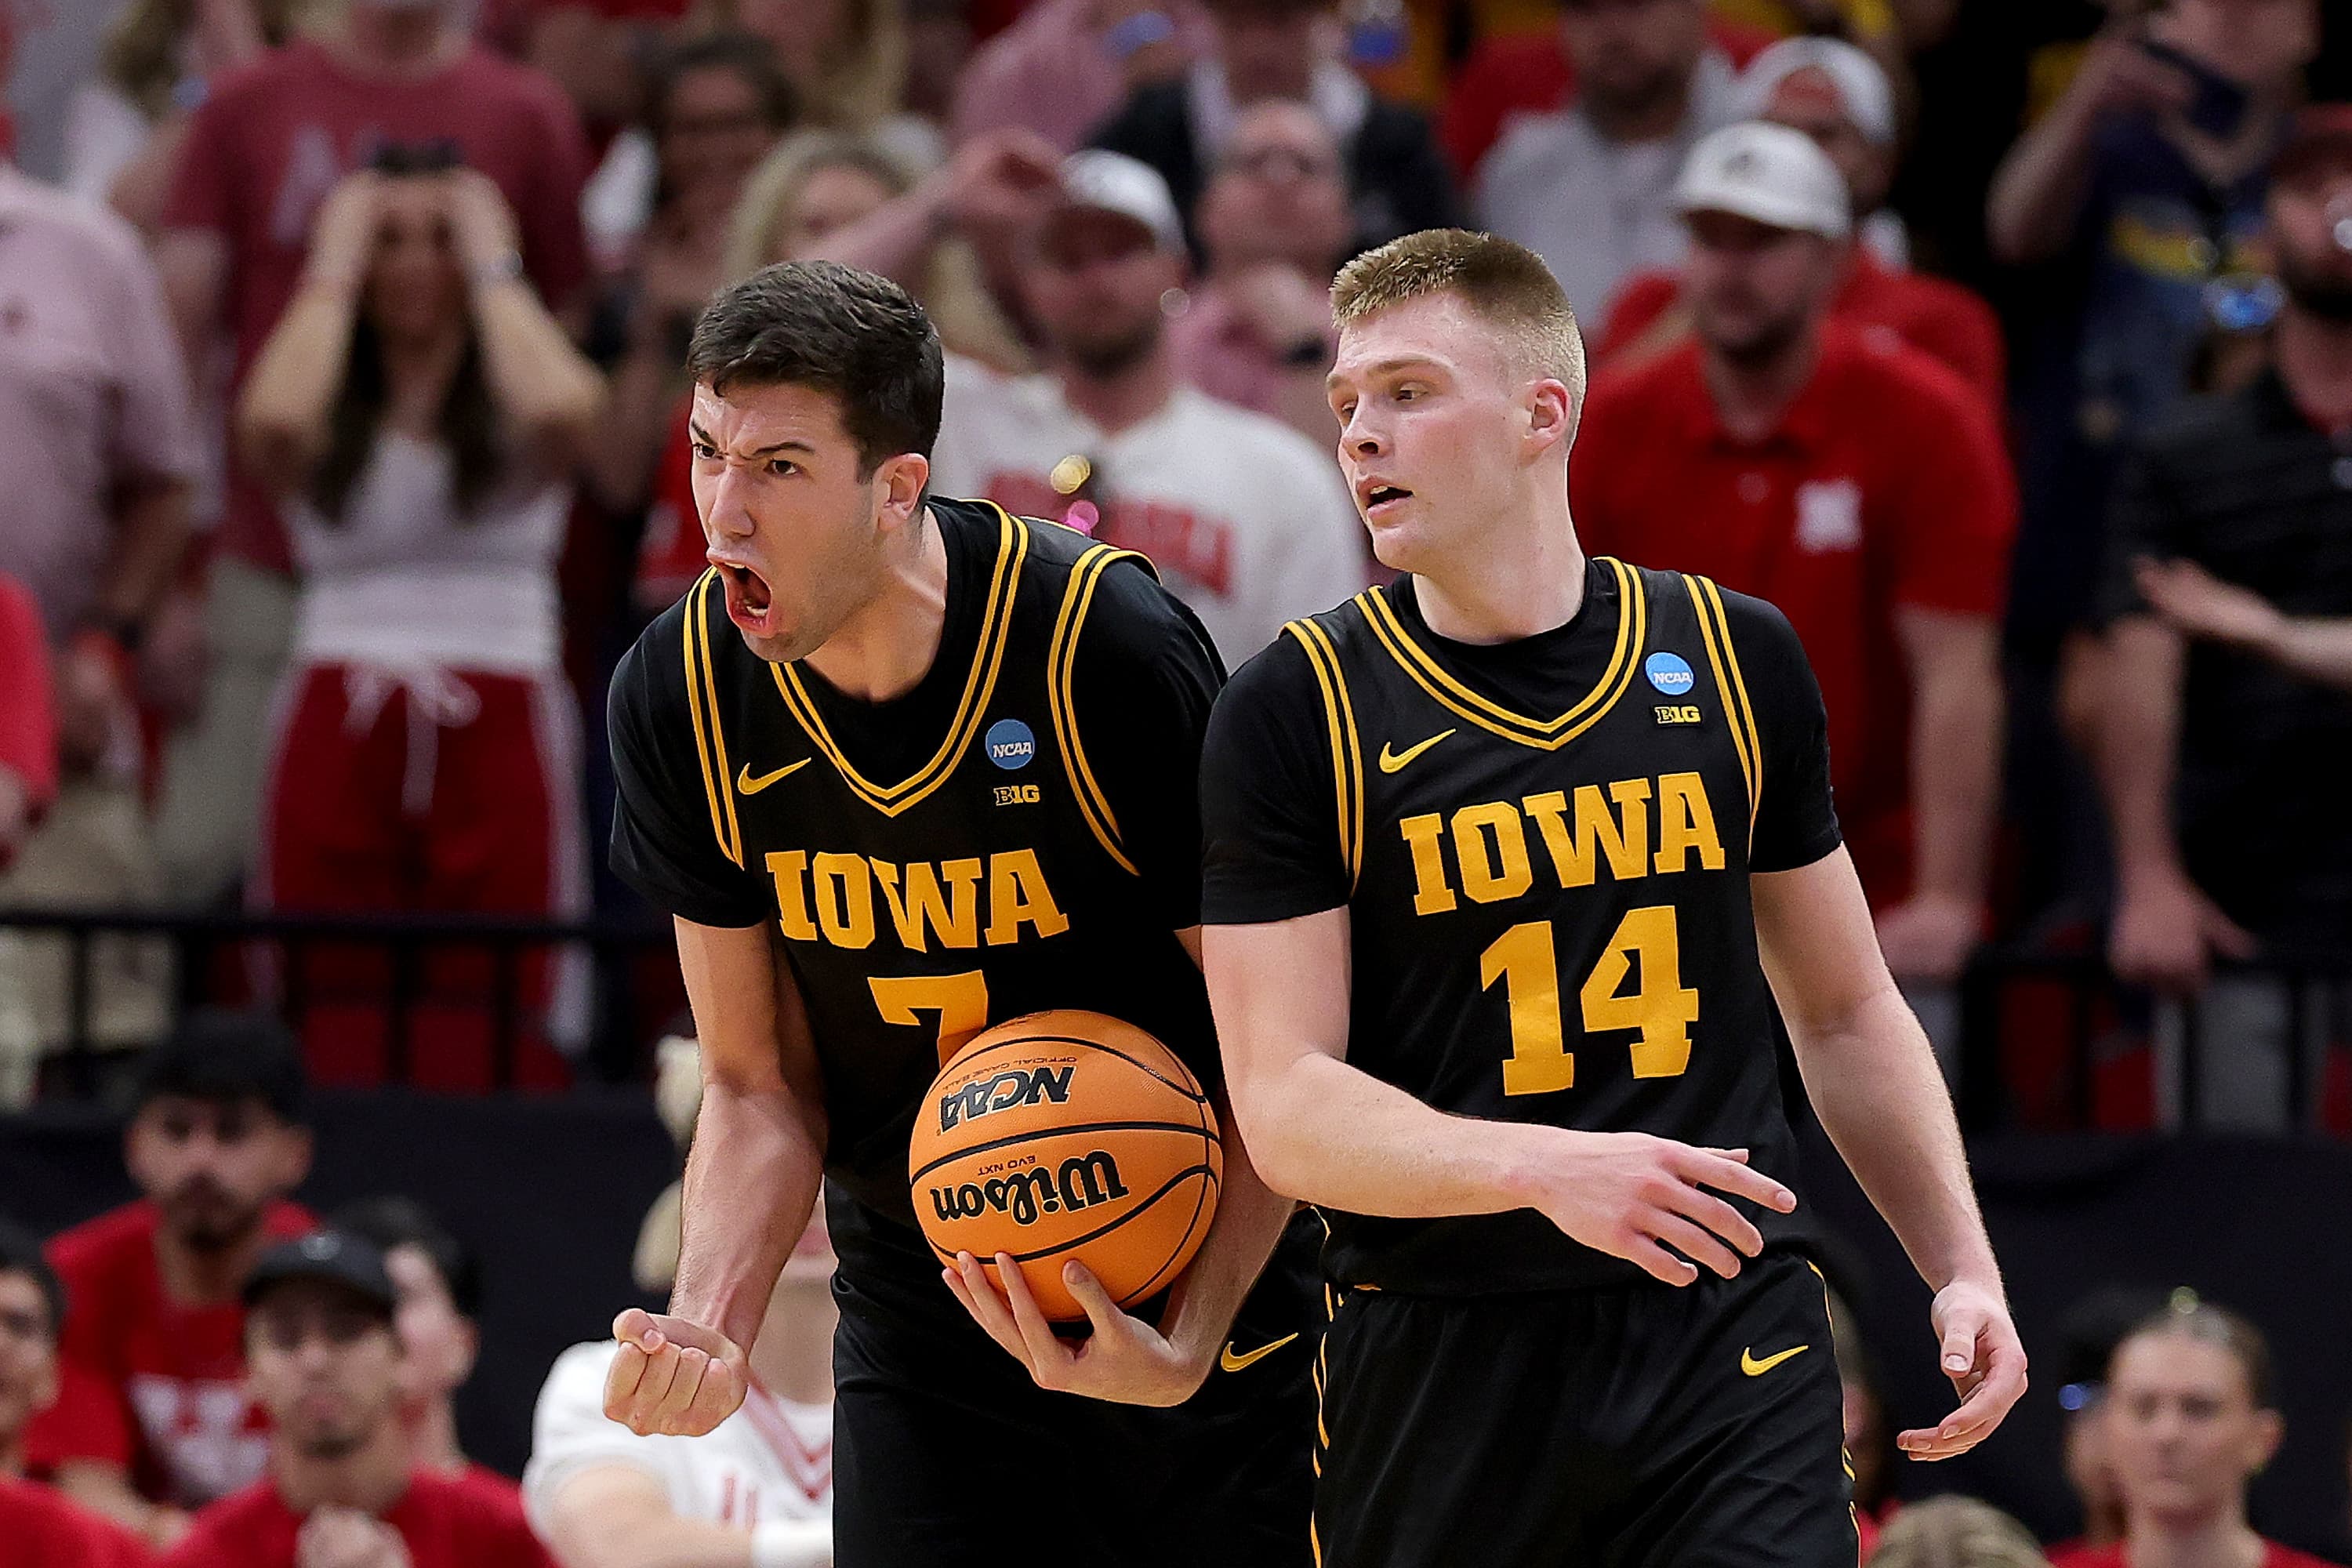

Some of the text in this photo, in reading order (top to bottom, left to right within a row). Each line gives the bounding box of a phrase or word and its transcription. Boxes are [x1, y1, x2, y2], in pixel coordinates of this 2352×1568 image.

[1653, 672, 1692, 684] NCAA
[993, 742, 1033, 758] NCAA
[1400, 771, 1726, 916] IOWA
[765, 848, 1069, 953] IOWA
[867, 970, 989, 1069] 7
[1480, 905, 1699, 1096] 14
[938, 1065, 1077, 1135] NCAA
[930, 1149, 1130, 1226] Wilson
[978, 1155, 1036, 1176] EVO NXT
